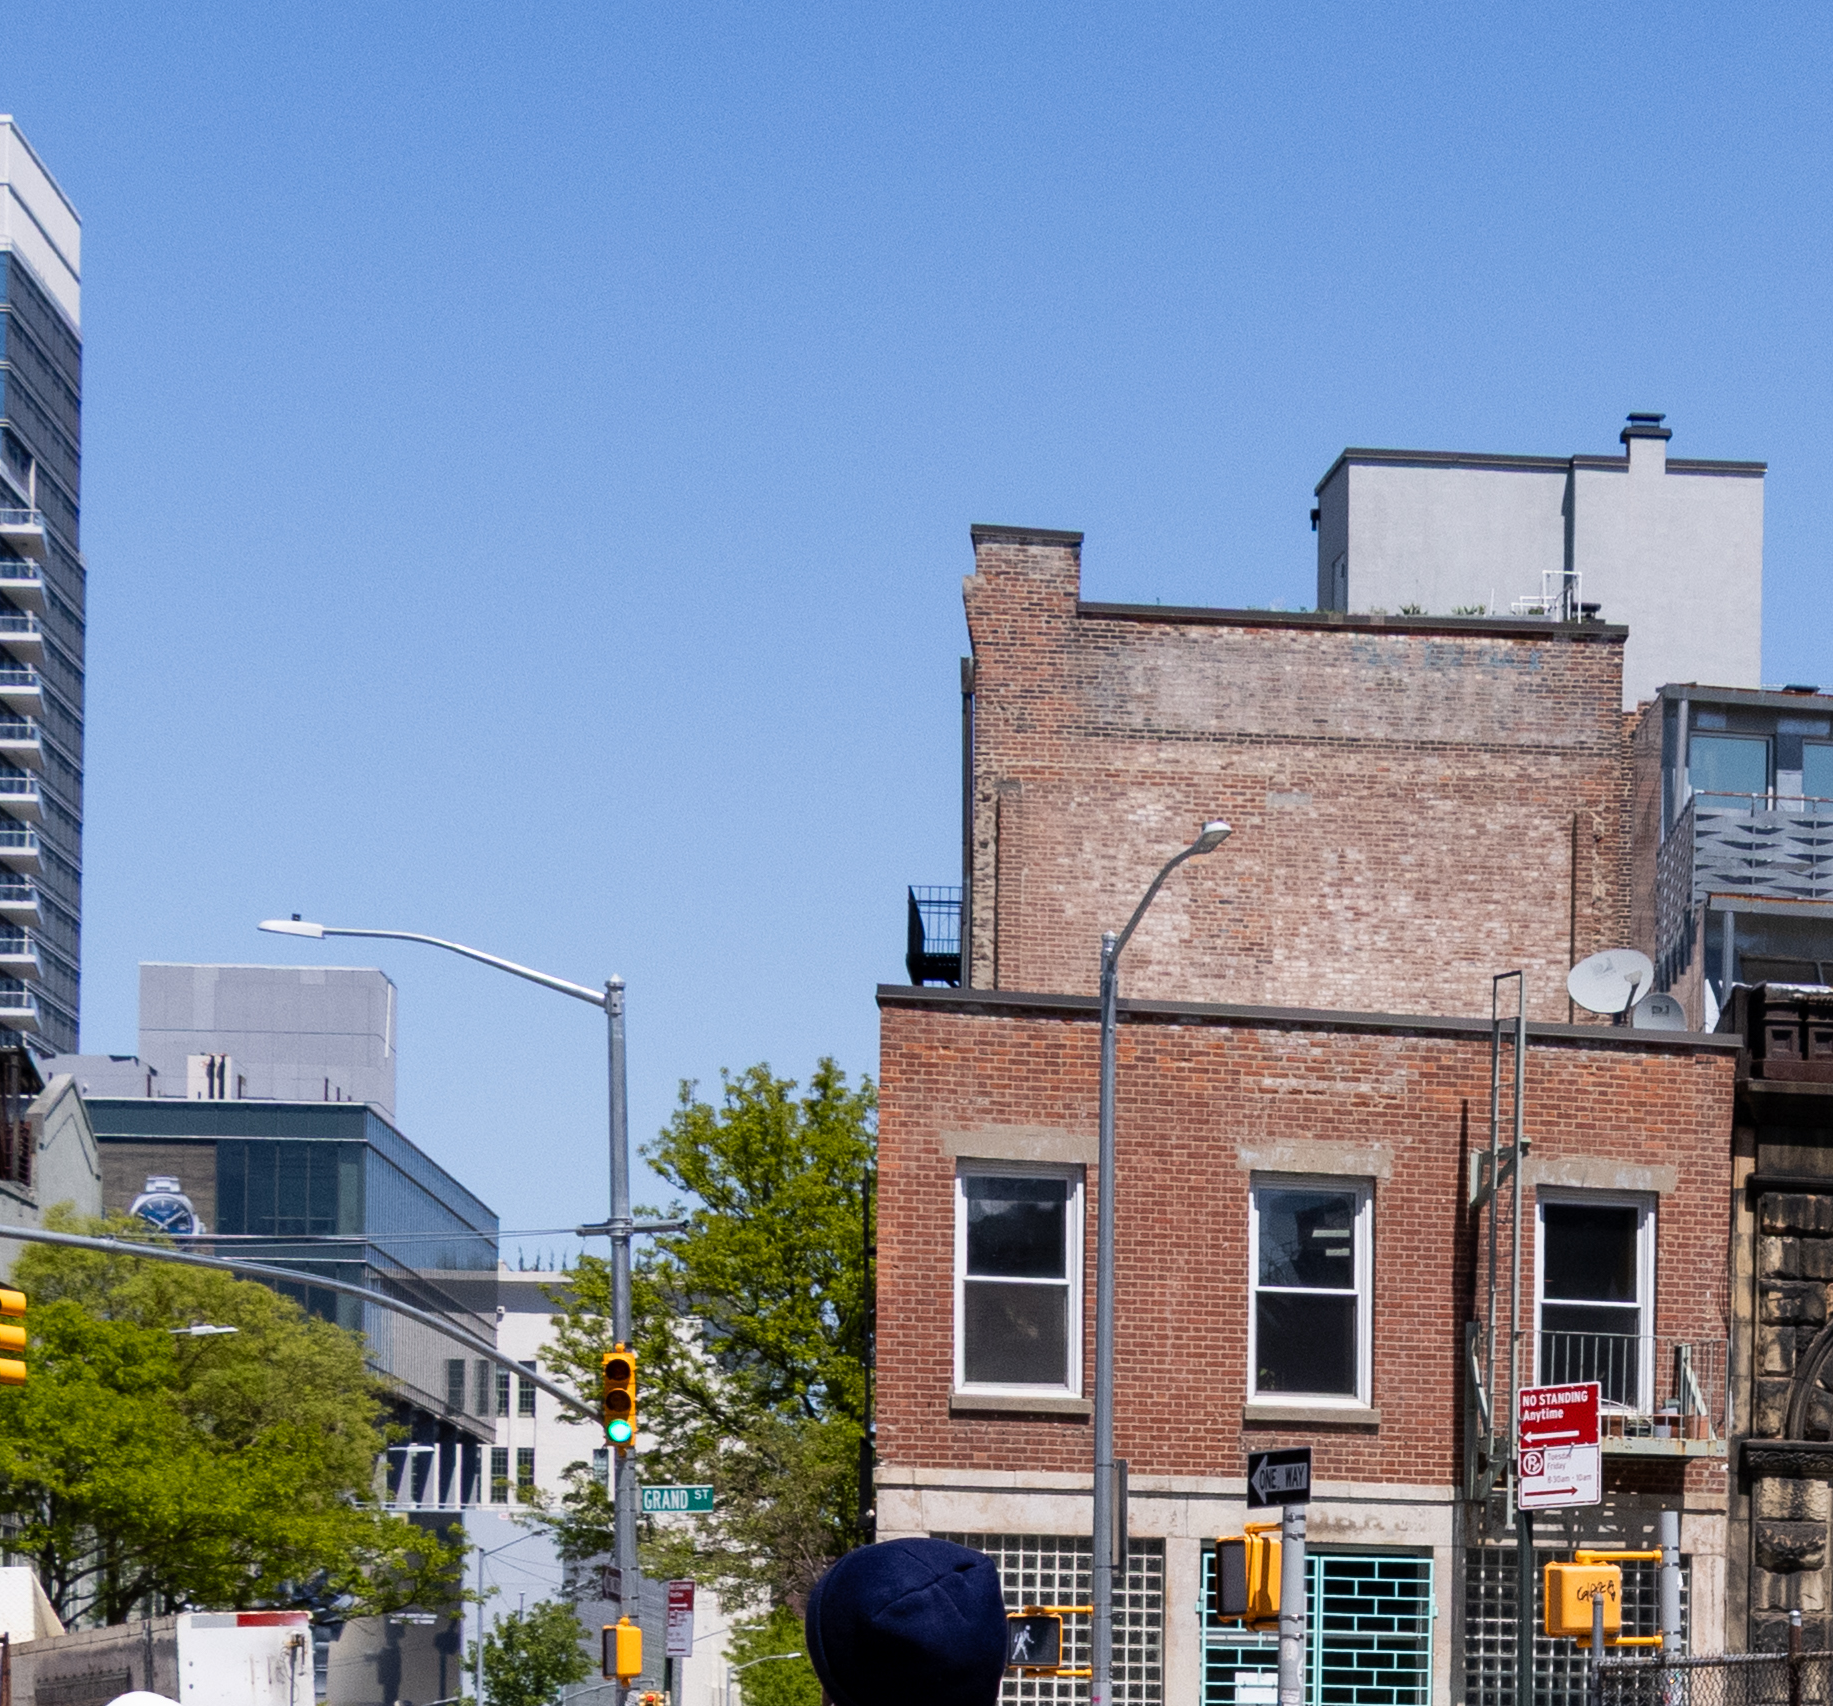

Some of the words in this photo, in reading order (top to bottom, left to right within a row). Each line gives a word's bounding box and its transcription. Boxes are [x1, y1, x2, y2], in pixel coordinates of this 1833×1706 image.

[1522, 1395, 1537, 1407] NO
[1539, 1390, 1588, 1406] STANDING
[1523, 1408, 1564, 1423] Anytime
[1259, 1469, 1277, 1491] ONE
[1285, 1466, 1305, 1488] WAY
[643, 1490, 689, 1510] GRAND
[694, 1489, 709, 1500] ST
